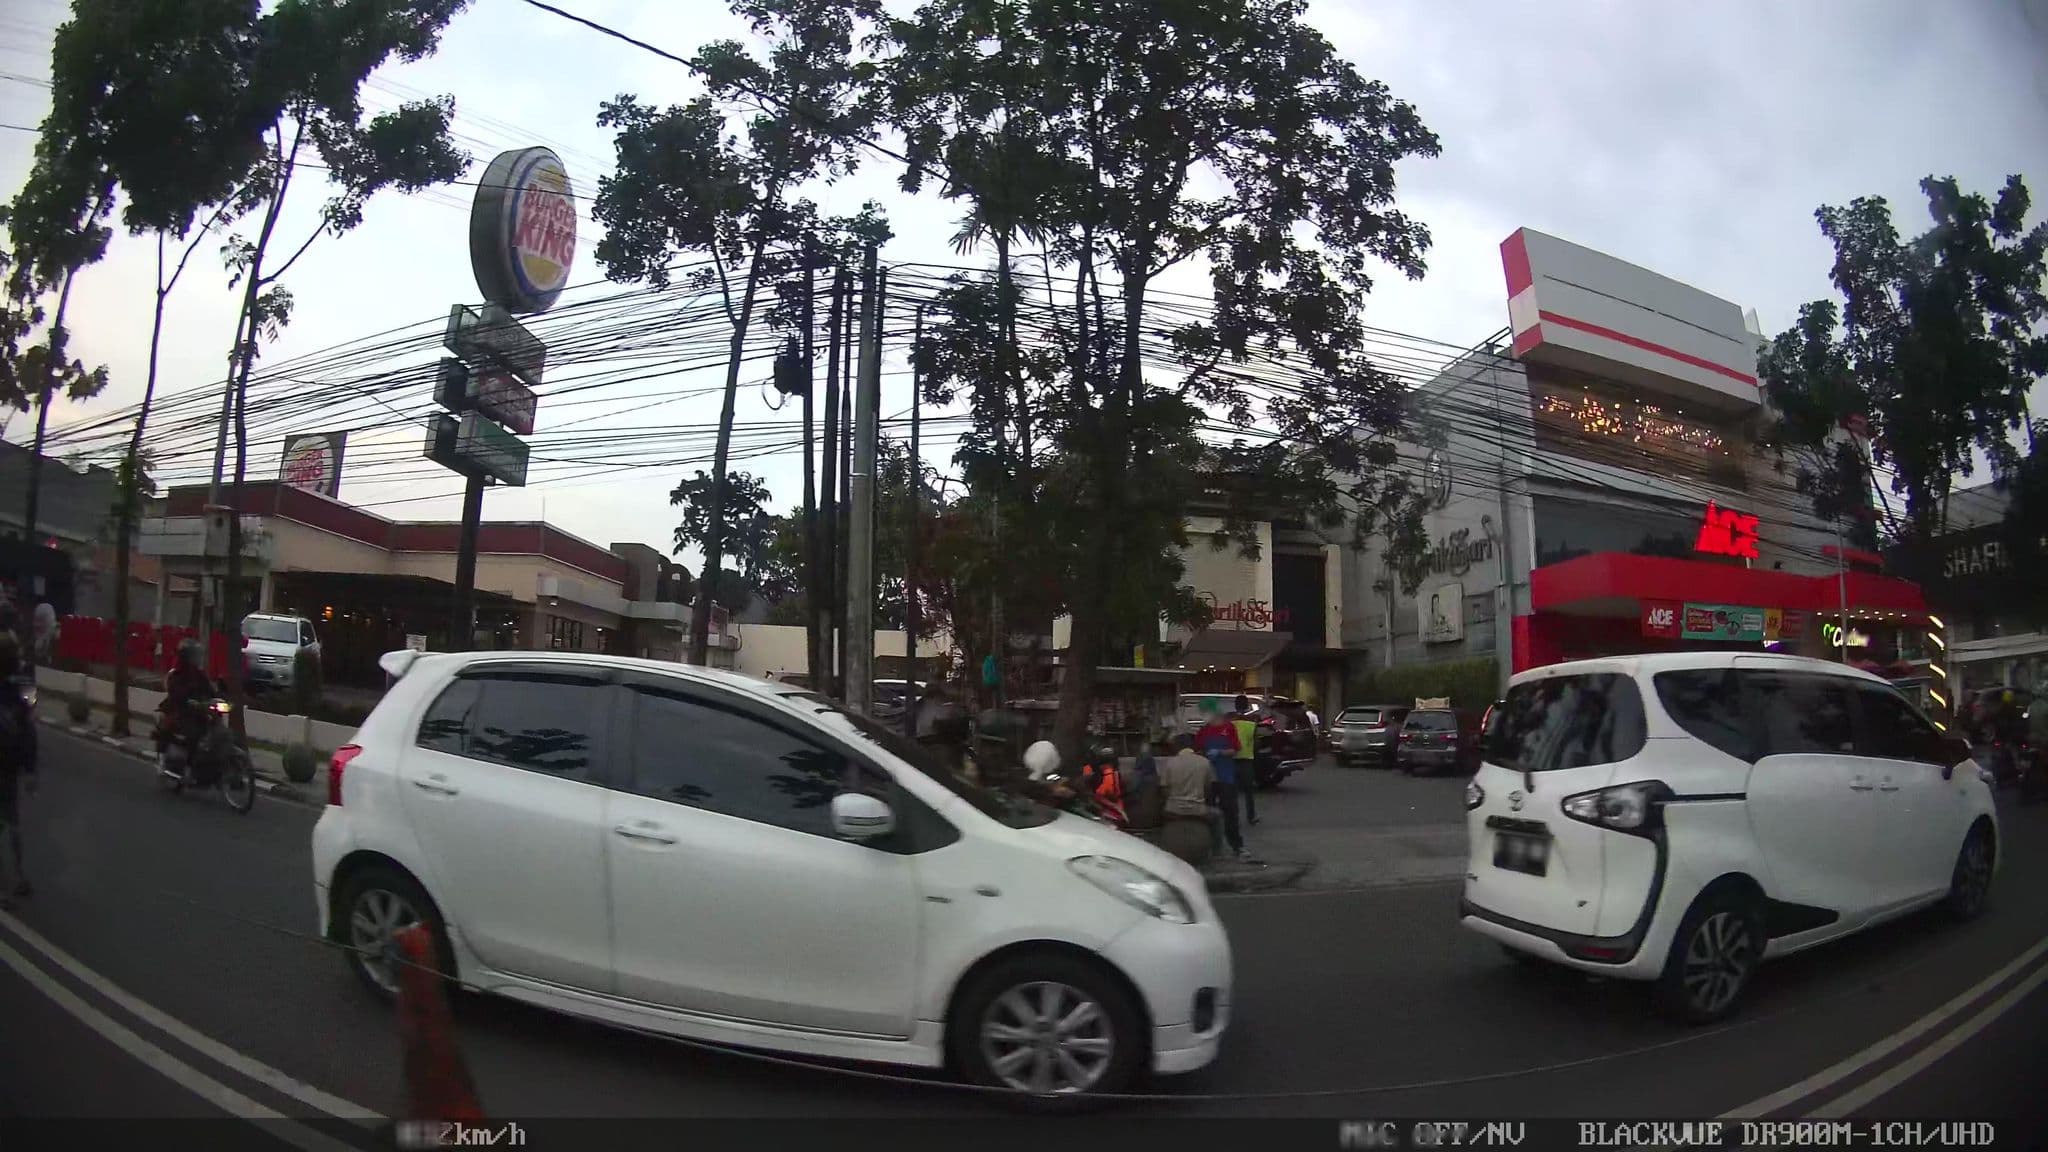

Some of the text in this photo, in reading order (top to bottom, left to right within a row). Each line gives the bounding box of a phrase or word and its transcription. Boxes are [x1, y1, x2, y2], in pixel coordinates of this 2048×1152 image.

[512, 209, 577, 267] KING
[1695, 498, 1760, 559] ACE
[1648, 608, 1673, 626] ACE
